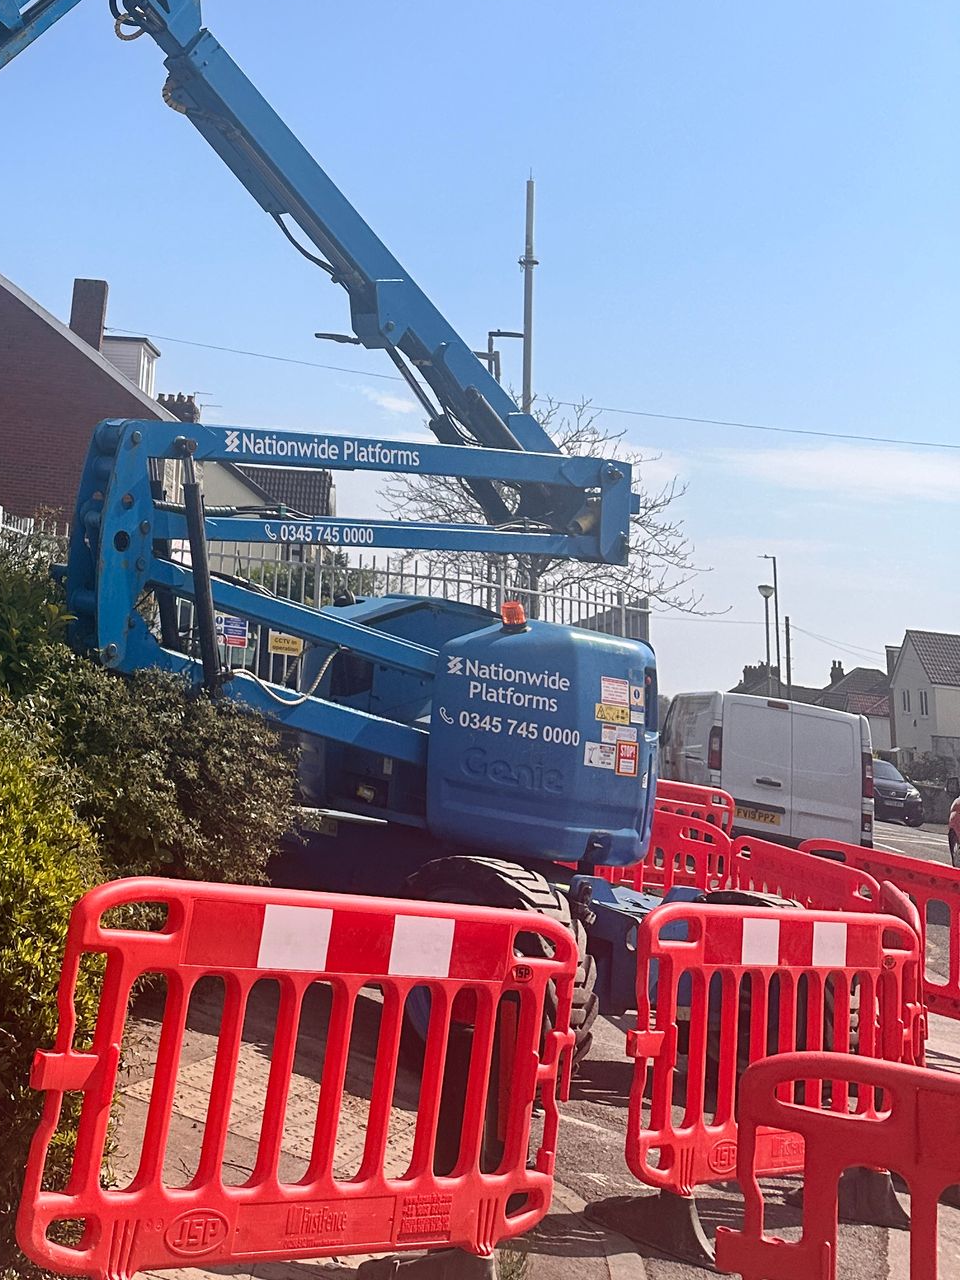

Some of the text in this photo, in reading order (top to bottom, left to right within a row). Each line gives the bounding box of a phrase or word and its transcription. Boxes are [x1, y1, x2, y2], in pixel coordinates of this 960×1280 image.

[242, 433, 420, 466] Nationwide Platforms
[280, 524, 374, 544] 0345 745 0000
[272, 645, 299, 653] operation
[274, 636, 290, 645] CCTV
[466, 659, 571, 691] Nationwide
[469, 681, 558, 712] Platforms
[459, 711, 502, 733] 0345
[507, 719, 538, 740] 745
[543, 726, 580, 747] 0000
[460, 746, 564, 794] Genie
[172, 1217, 221, 1247] JSP
